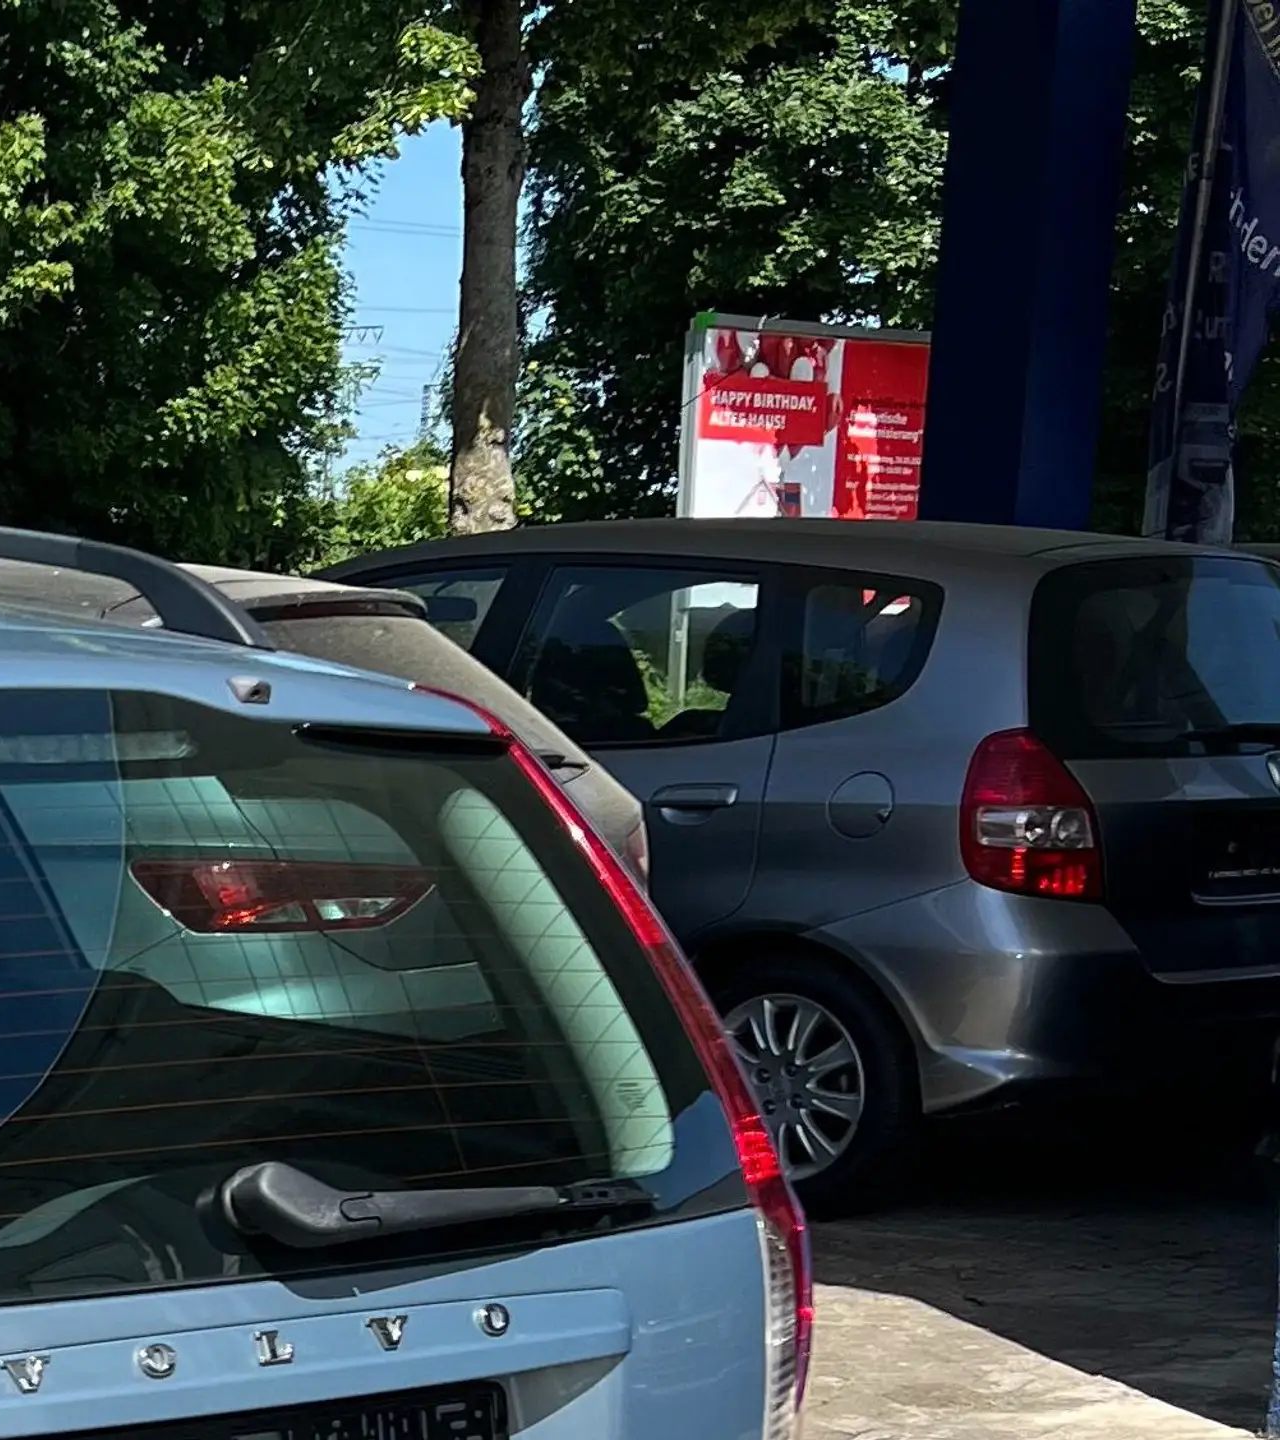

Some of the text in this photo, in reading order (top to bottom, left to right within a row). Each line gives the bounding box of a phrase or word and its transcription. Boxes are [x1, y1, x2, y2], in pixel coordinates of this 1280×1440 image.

[710, 388, 818, 413] HAPPY BIRTHDAY,
[748, 413, 786, 431] HAUS!
